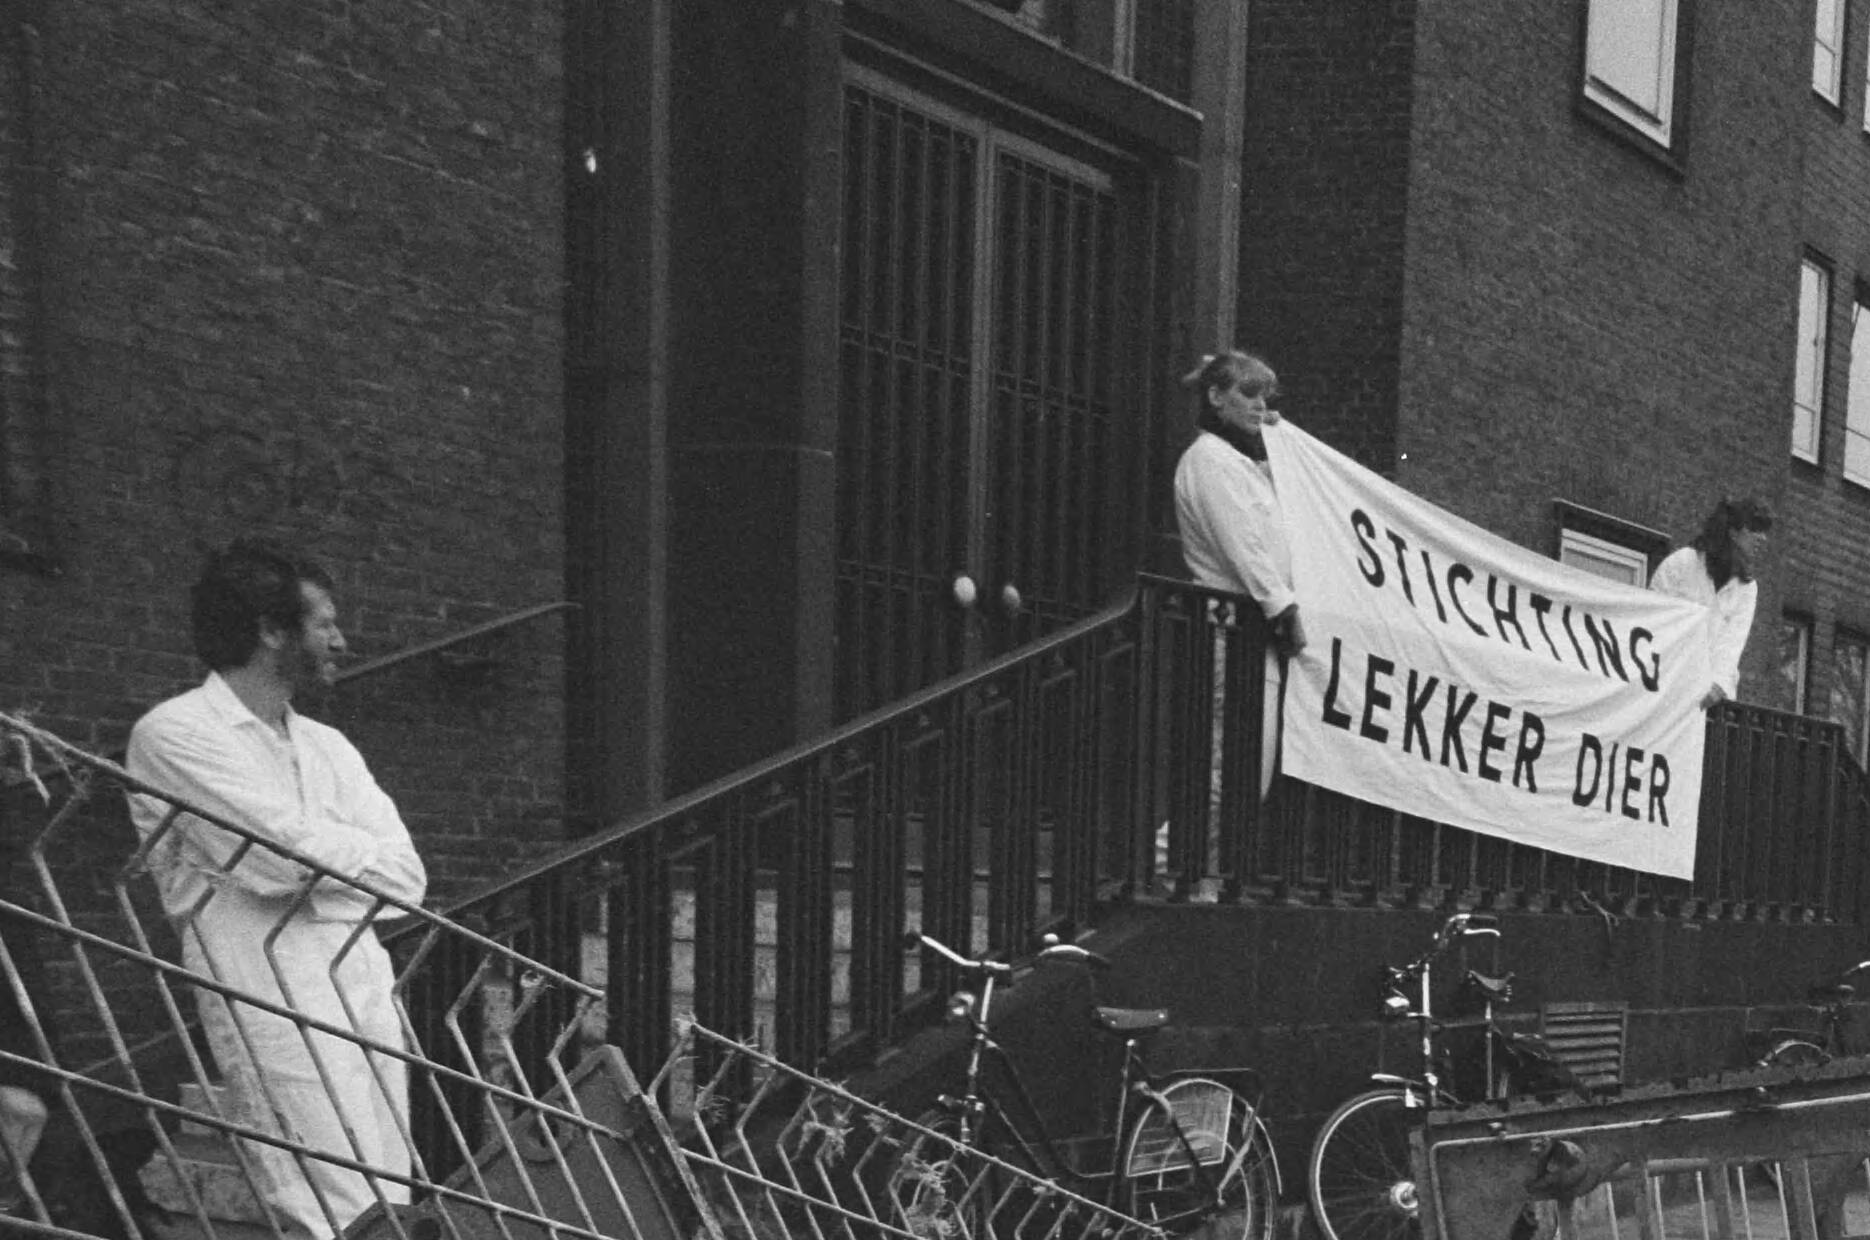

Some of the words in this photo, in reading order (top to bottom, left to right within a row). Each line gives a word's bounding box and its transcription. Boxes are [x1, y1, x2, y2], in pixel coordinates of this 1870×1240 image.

[1350, 508, 1661, 692] STICHTING
[1321, 637, 1546, 793] LEKKER
[1572, 733, 1670, 828] DIER
